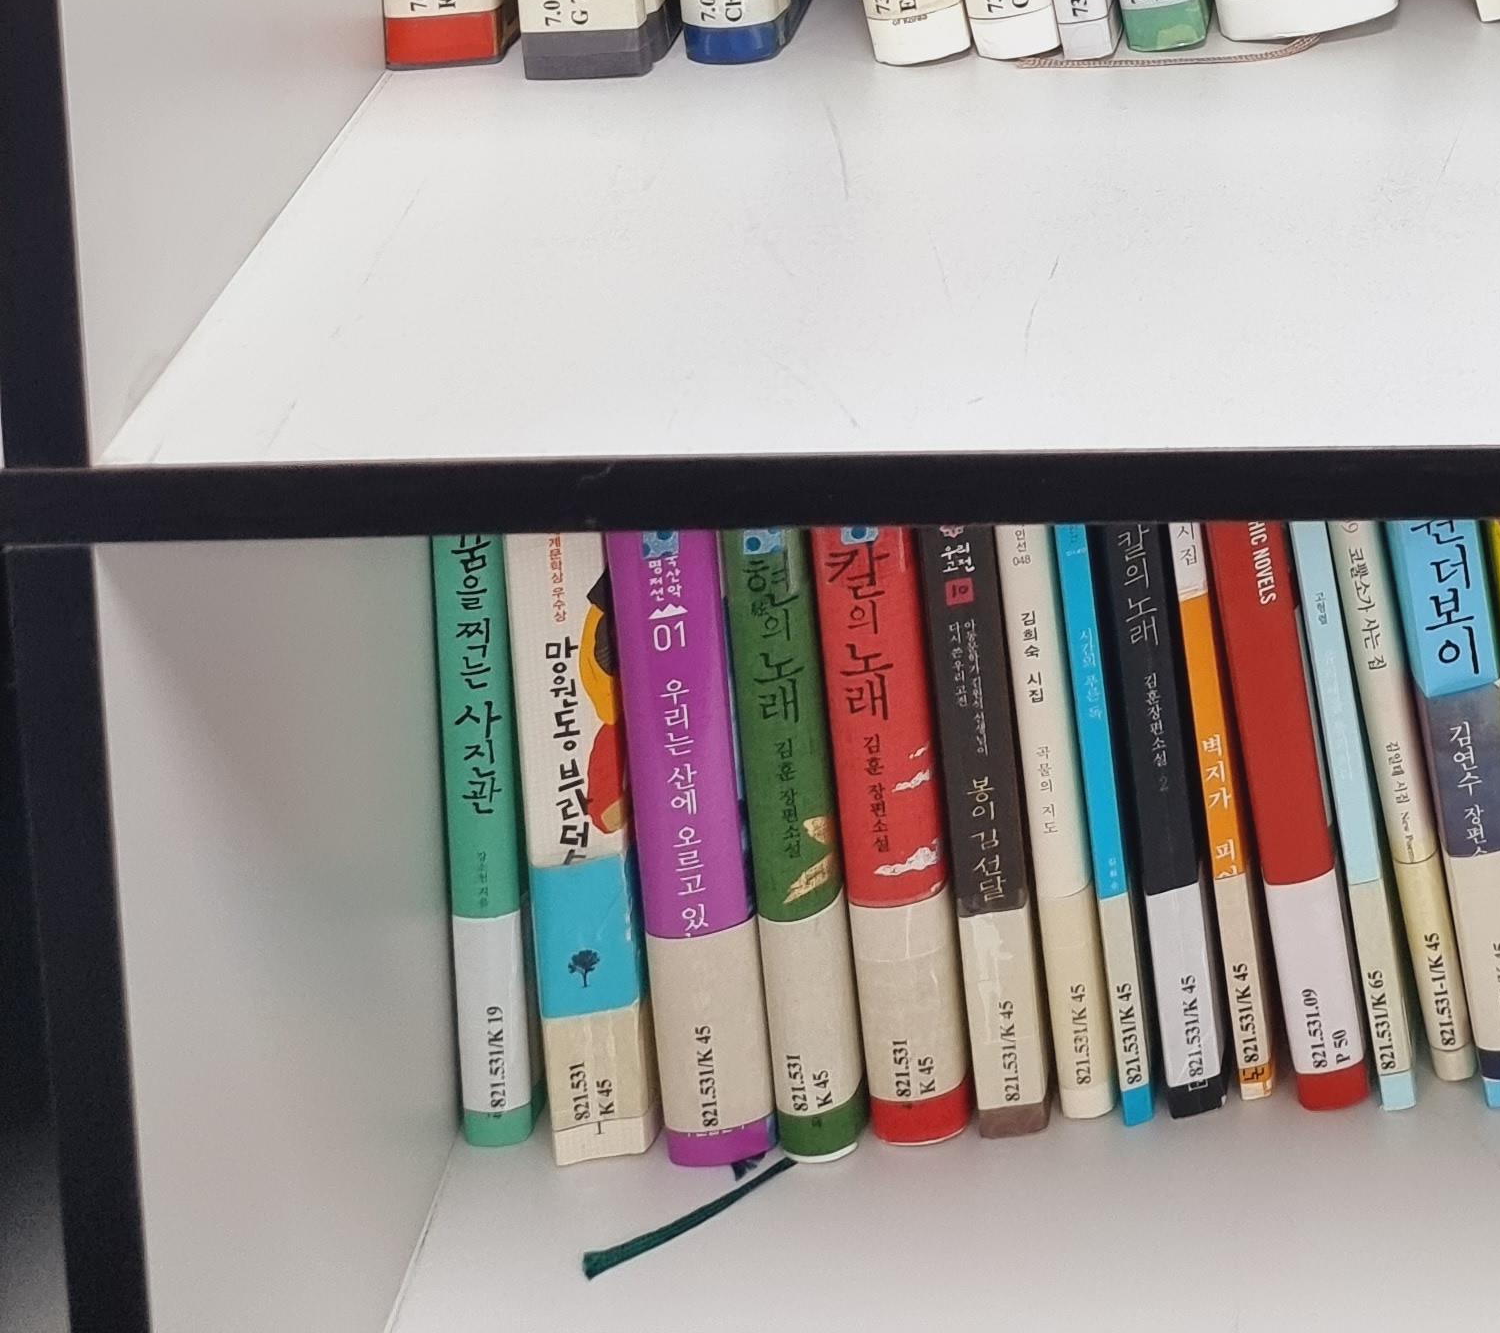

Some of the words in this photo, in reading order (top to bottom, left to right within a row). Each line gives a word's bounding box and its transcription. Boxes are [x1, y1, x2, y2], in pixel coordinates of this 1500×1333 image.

[1252, 547, 1277, 606] NOVELS
[653, 621, 687, 652] 01
[1021, 611, 1040, 659] 김희숙
[1361, 617, 1381, 651] 사는
[753, 652, 805, 723] 노래
[840, 643, 893, 721] 노래
[1027, 671, 1044, 704] 시집
[660, 679, 694, 756] 우리는
[455, 700, 502, 815] 사진관
[775, 739, 795, 781] 김훈
[1036, 745, 1054, 793] 곡물의
[1202, 734, 1232, 811] 벽지가
[1450, 721, 1483, 796] 김연수
[966, 776, 996, 821] 봉이
[1042, 803, 1059, 835] 지도
[672, 826, 706, 897] 오르고
[1424, 933, 1440, 950] 45
[1233, 963, 1248, 981] 45
[1368, 970, 1384, 987] 65
[1427, 954, 1456, 1046] 821.531-1/K
[998, 1000, 1014, 1019] 45
[1185, 1000, 1204, 1077] 821.531/K
[1235, 986, 1259, 1063] 821.531/K
[1303, 989, 1327, 1068] 821.531.09
[489, 1026, 507, 1109] 821.531/K
[893, 1039, 911, 1097] 821.531
[918, 1056, 934, 1077] 45
[1000, 1024, 1020, 1102] 821.531/K
[1072, 1010, 1092, 1084] 821.531/K
[1121, 1005, 1142, 1084] 821.531/K
[1332, 1029, 1349, 1049] 50
[569, 1061, 590, 1121] 821.531
[597, 1078, 613, 1098] 45
[786, 1054, 808, 1111] 821.531
[813, 1070, 829, 1090] 45
